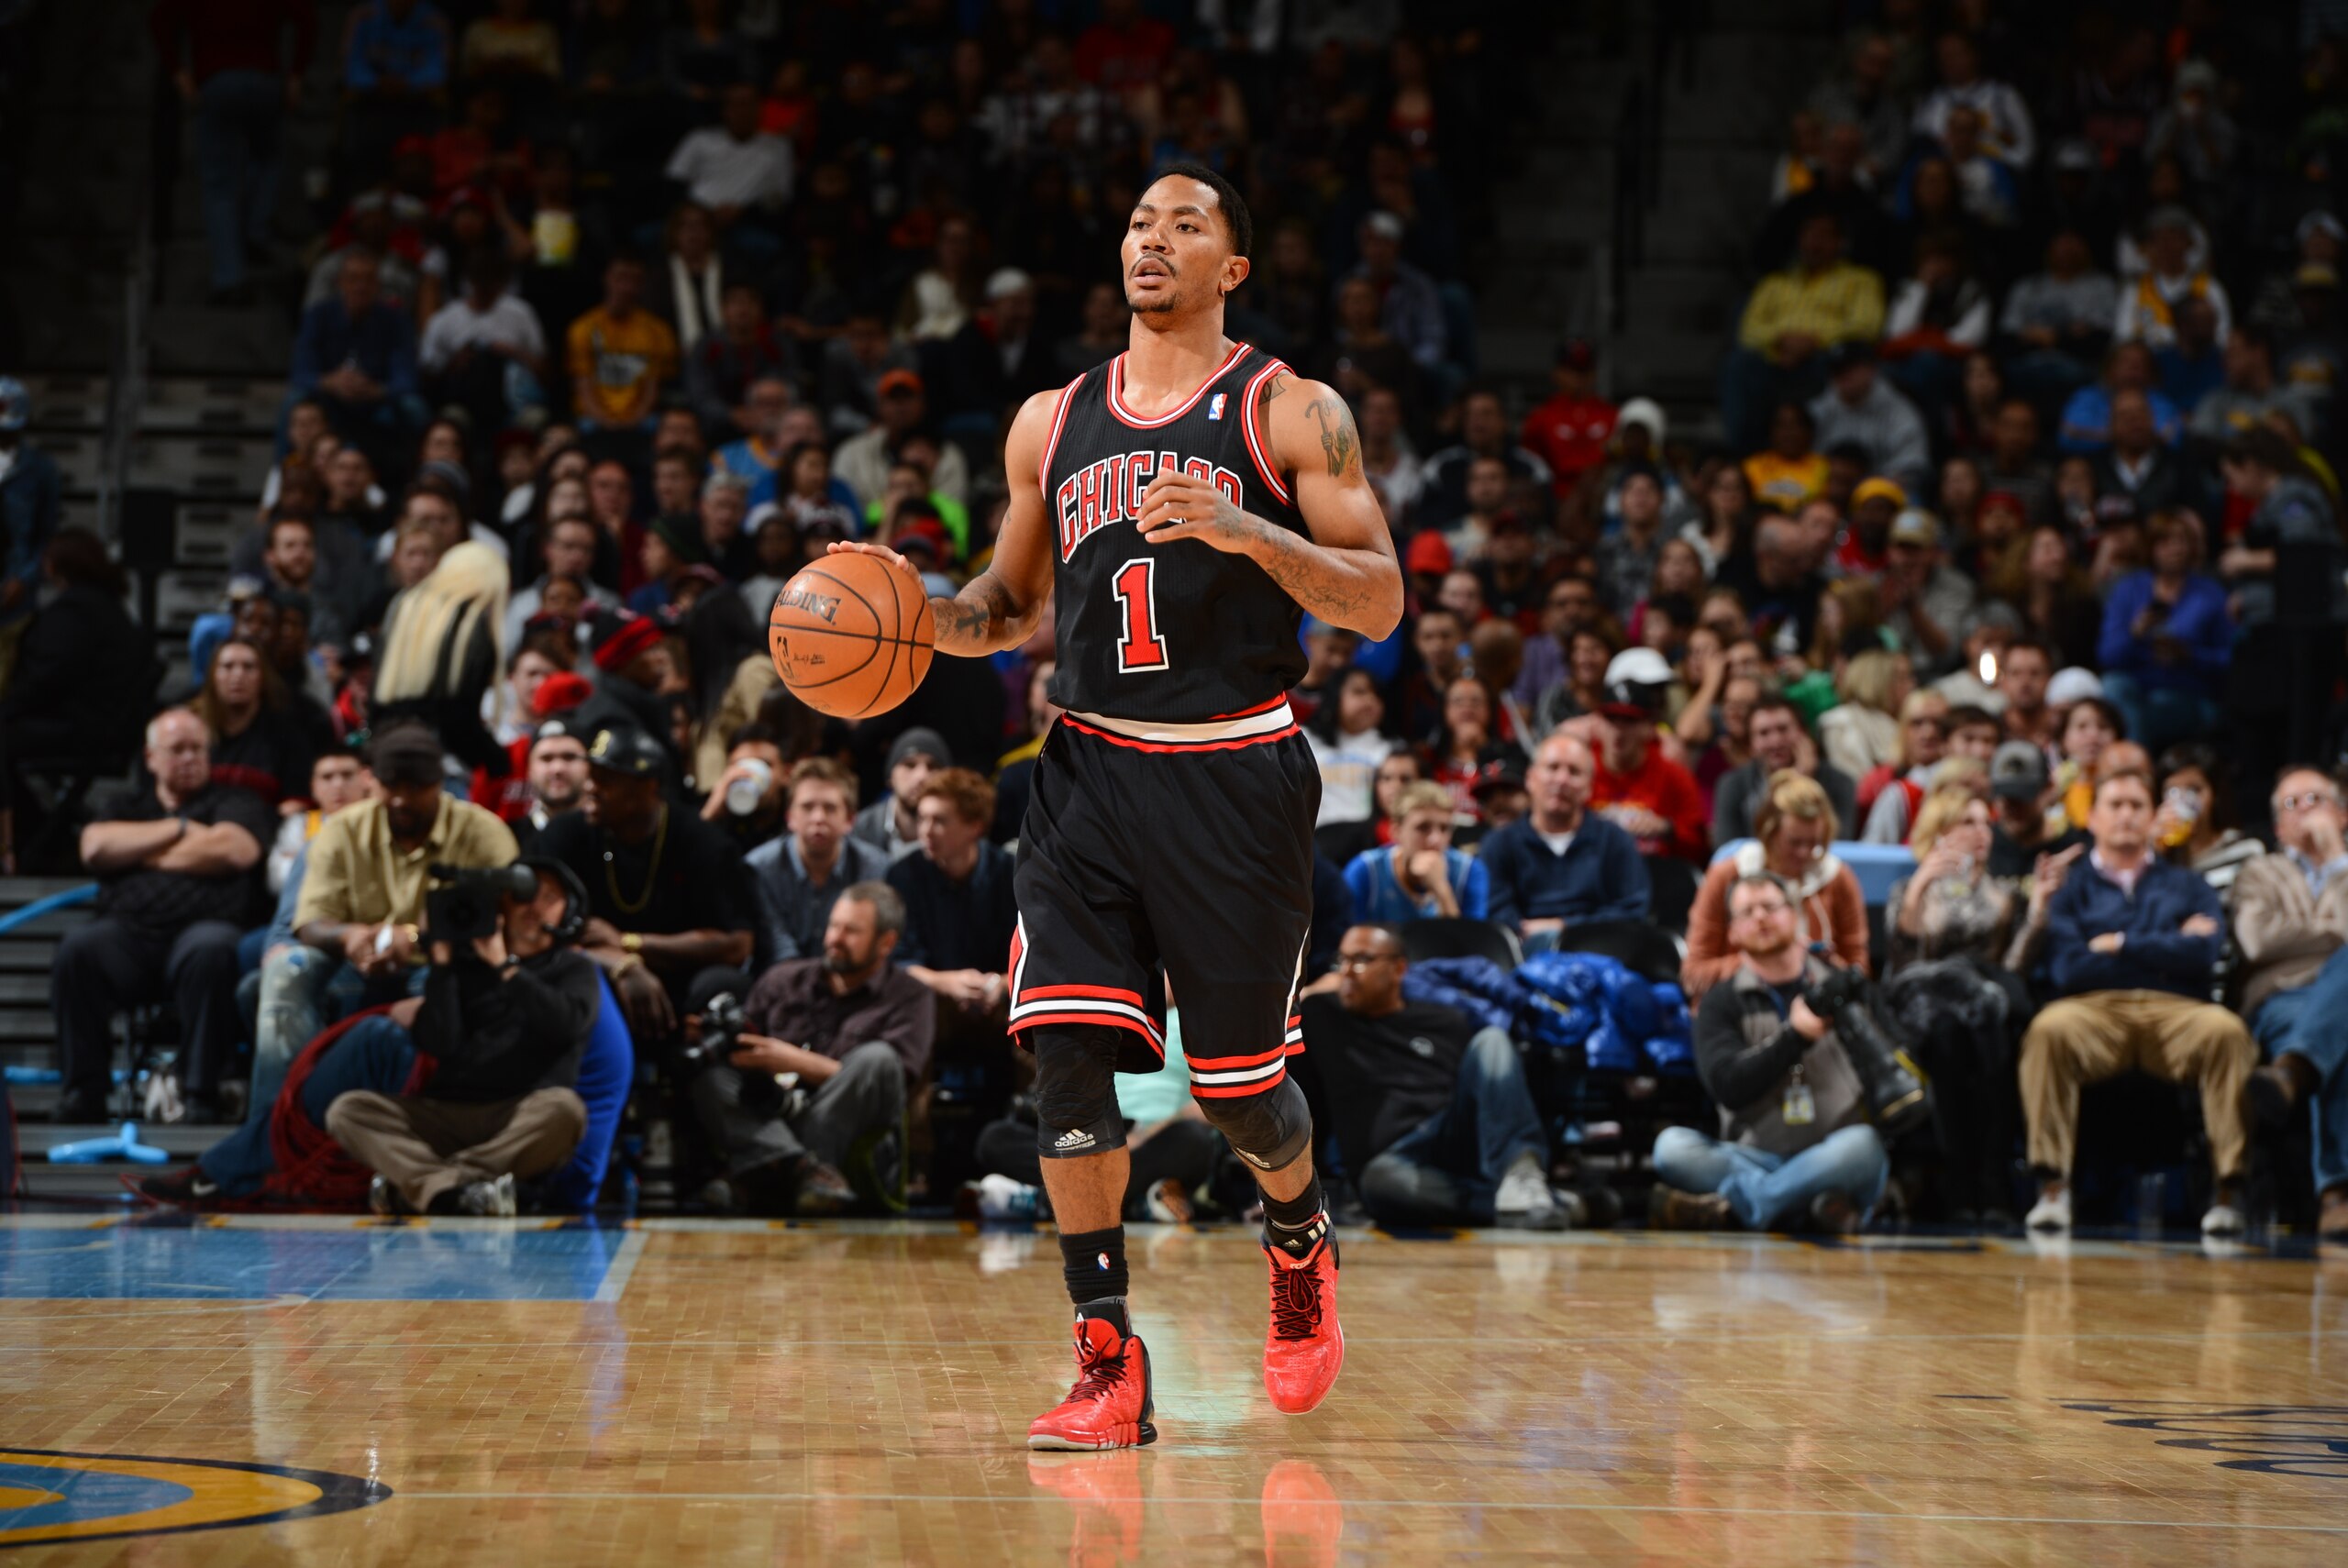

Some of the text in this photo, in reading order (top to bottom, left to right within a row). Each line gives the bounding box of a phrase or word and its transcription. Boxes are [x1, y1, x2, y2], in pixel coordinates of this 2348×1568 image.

[776, 590, 841, 624] ALDING
[1113, 558, 1169, 674] 1
[1055, 1133, 1094, 1147] adidas
